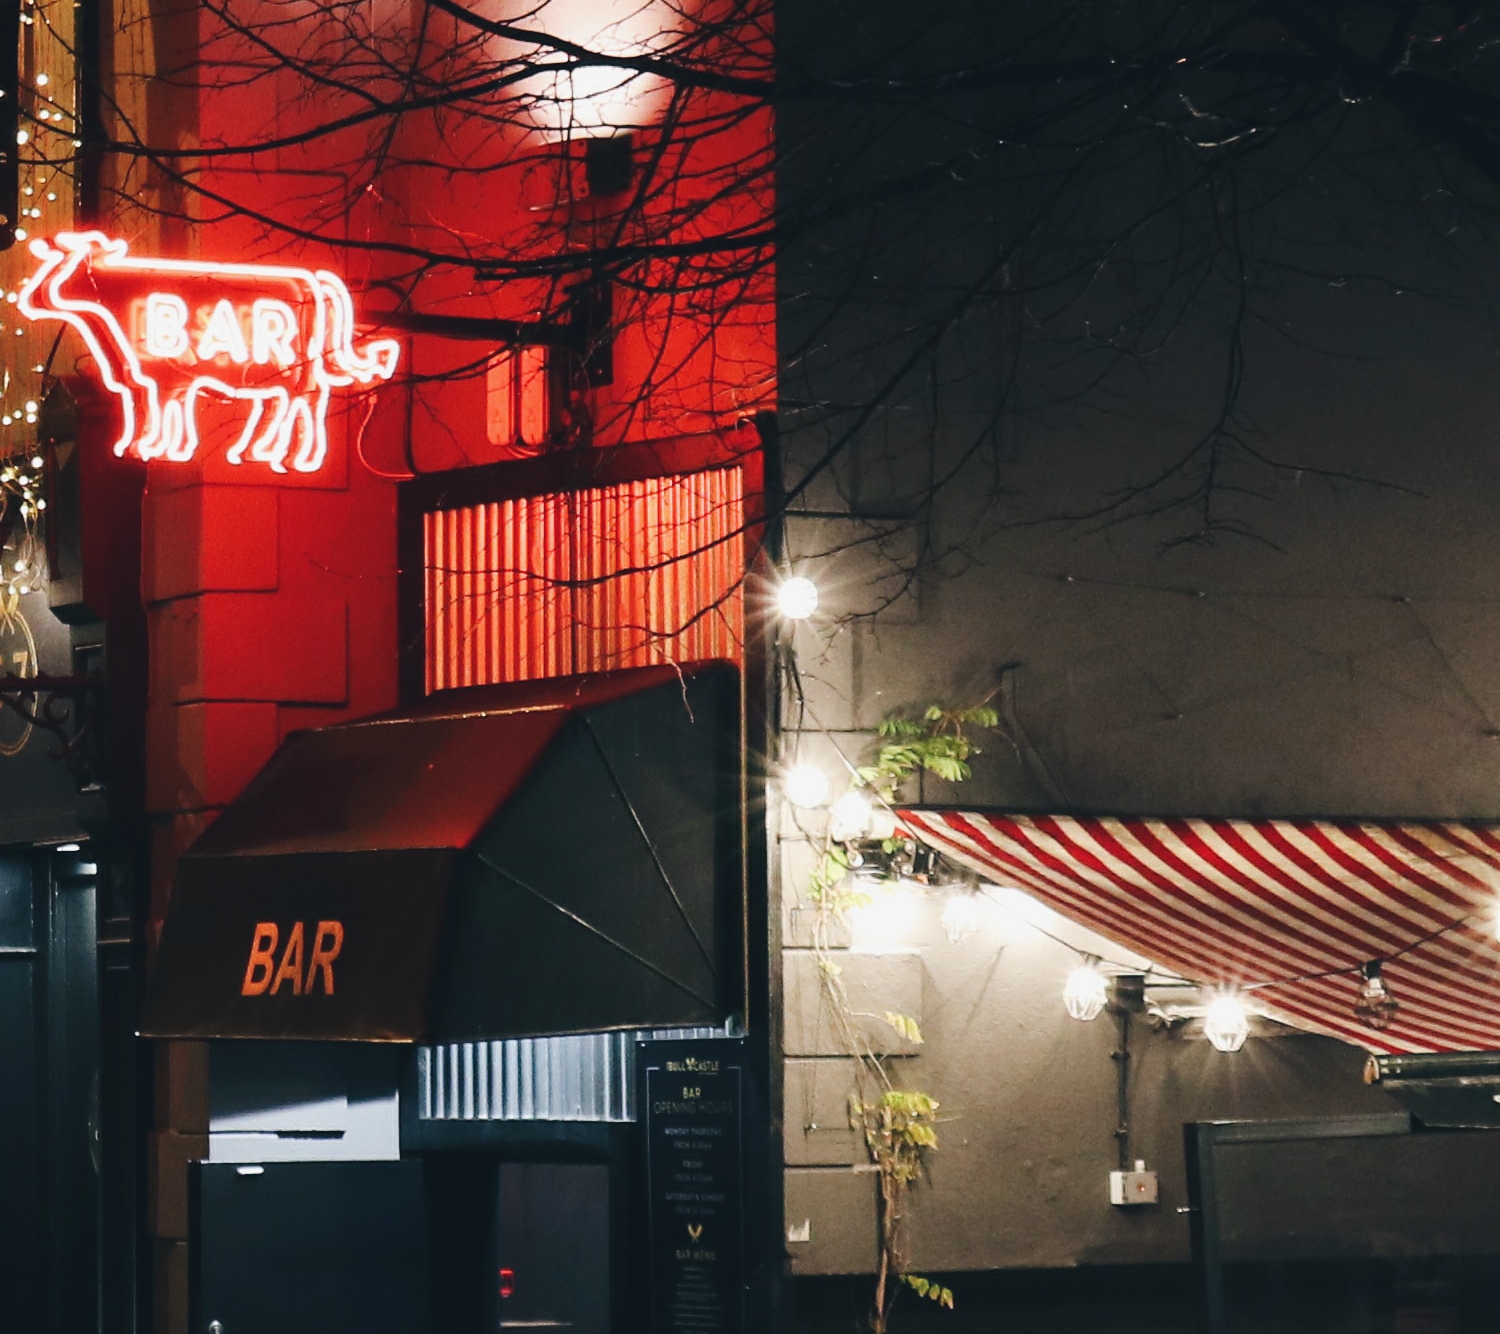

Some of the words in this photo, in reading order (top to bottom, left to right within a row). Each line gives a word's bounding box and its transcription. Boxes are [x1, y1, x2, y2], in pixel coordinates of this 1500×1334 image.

[146, 293, 299, 366] BAR
[241, 920, 344, 996] BAR
[682, 1087, 702, 1099] BAR
